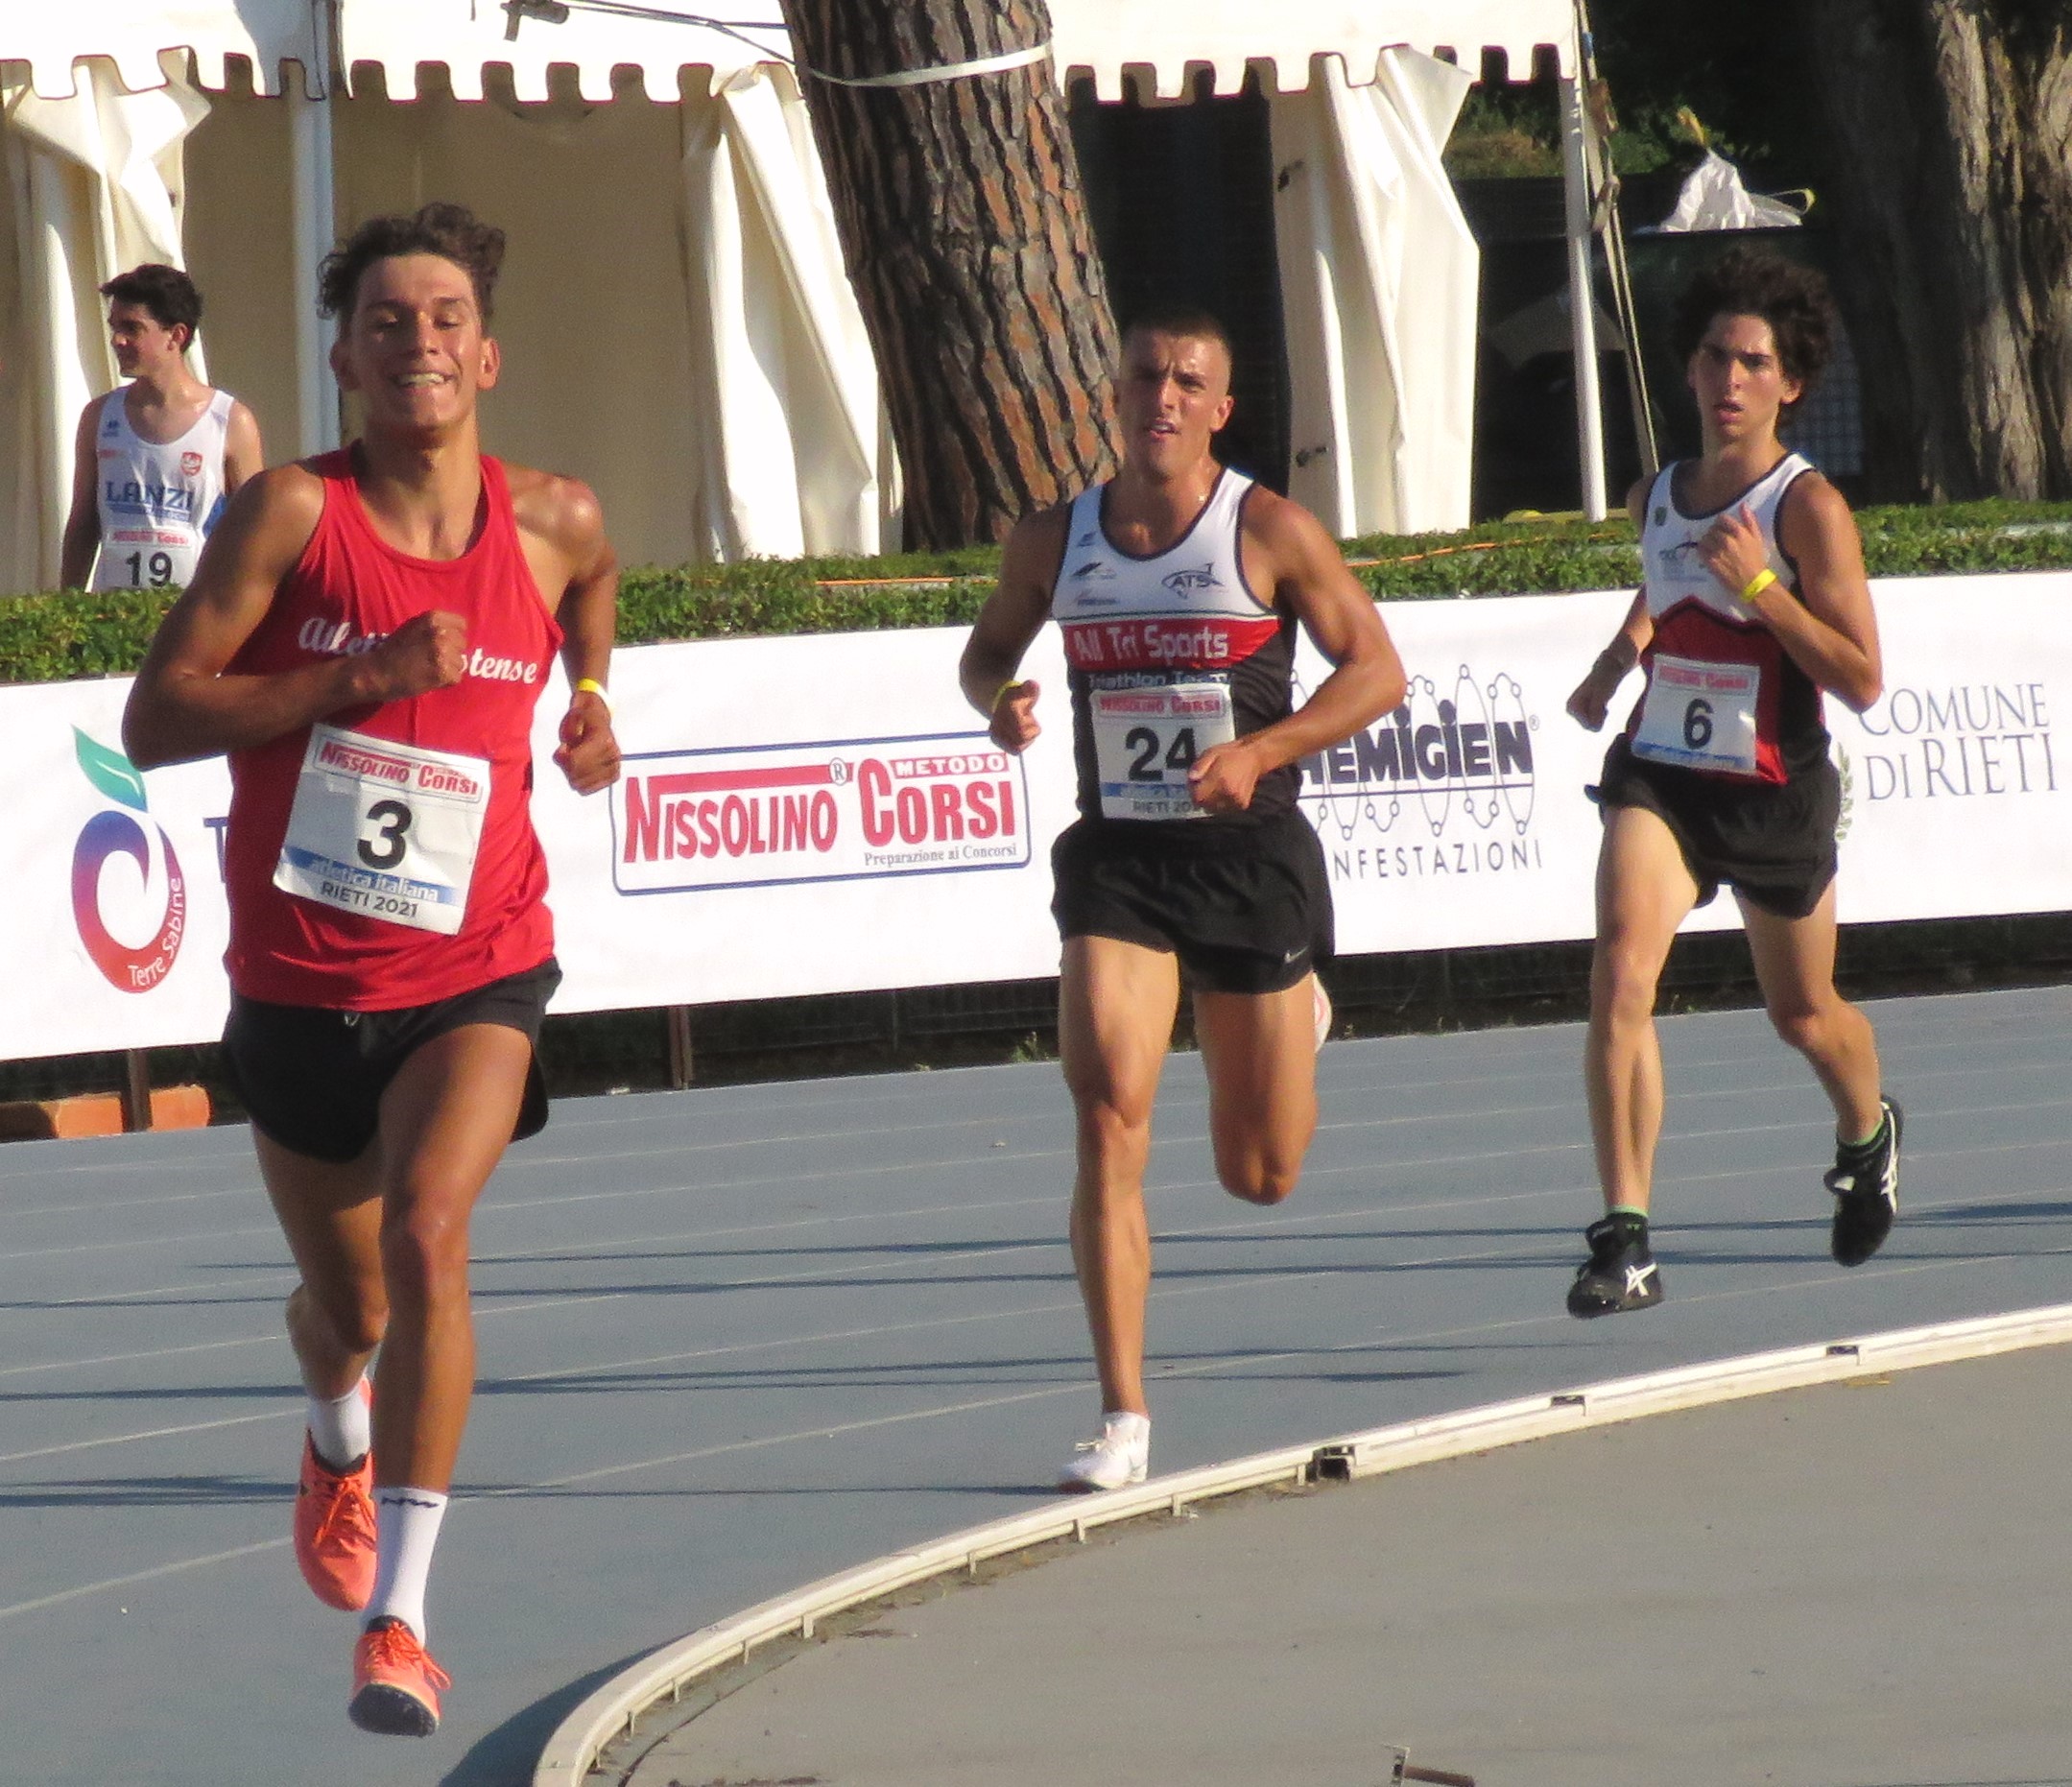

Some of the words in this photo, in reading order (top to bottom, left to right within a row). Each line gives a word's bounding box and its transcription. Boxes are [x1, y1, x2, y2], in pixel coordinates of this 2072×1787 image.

[106, 481, 195, 512] LANZI
[126, 551, 173, 587] 19
[1072, 630, 1103, 660] All
[1108, 627, 1138, 660] Tri
[1143, 624, 1229, 666] Sports
[1683, 698, 1714, 750] 6
[894, 752, 1007, 778] METODO
[1125, 727, 1197, 782] 24
[1864, 753, 1913, 801] DI
[1919, 732, 2060, 798] RIETI
[624, 775, 839, 864] NISSOLINO
[858, 758, 1016, 847] CORSI
[357, 798, 414, 870] 3
[864, 848, 945, 869] Preparazione
[947, 846, 961, 861] ai
[962, 843, 1017, 861] Concorsi
[1333, 839, 1542, 881] NFESTAZIONI
[320, 881, 370, 908] RIETI
[372, 896, 420, 918] 2021
[374, 873, 440, 902] italiana
[128, 957, 166, 988] Terre
[161, 877, 183, 960] Sabine
